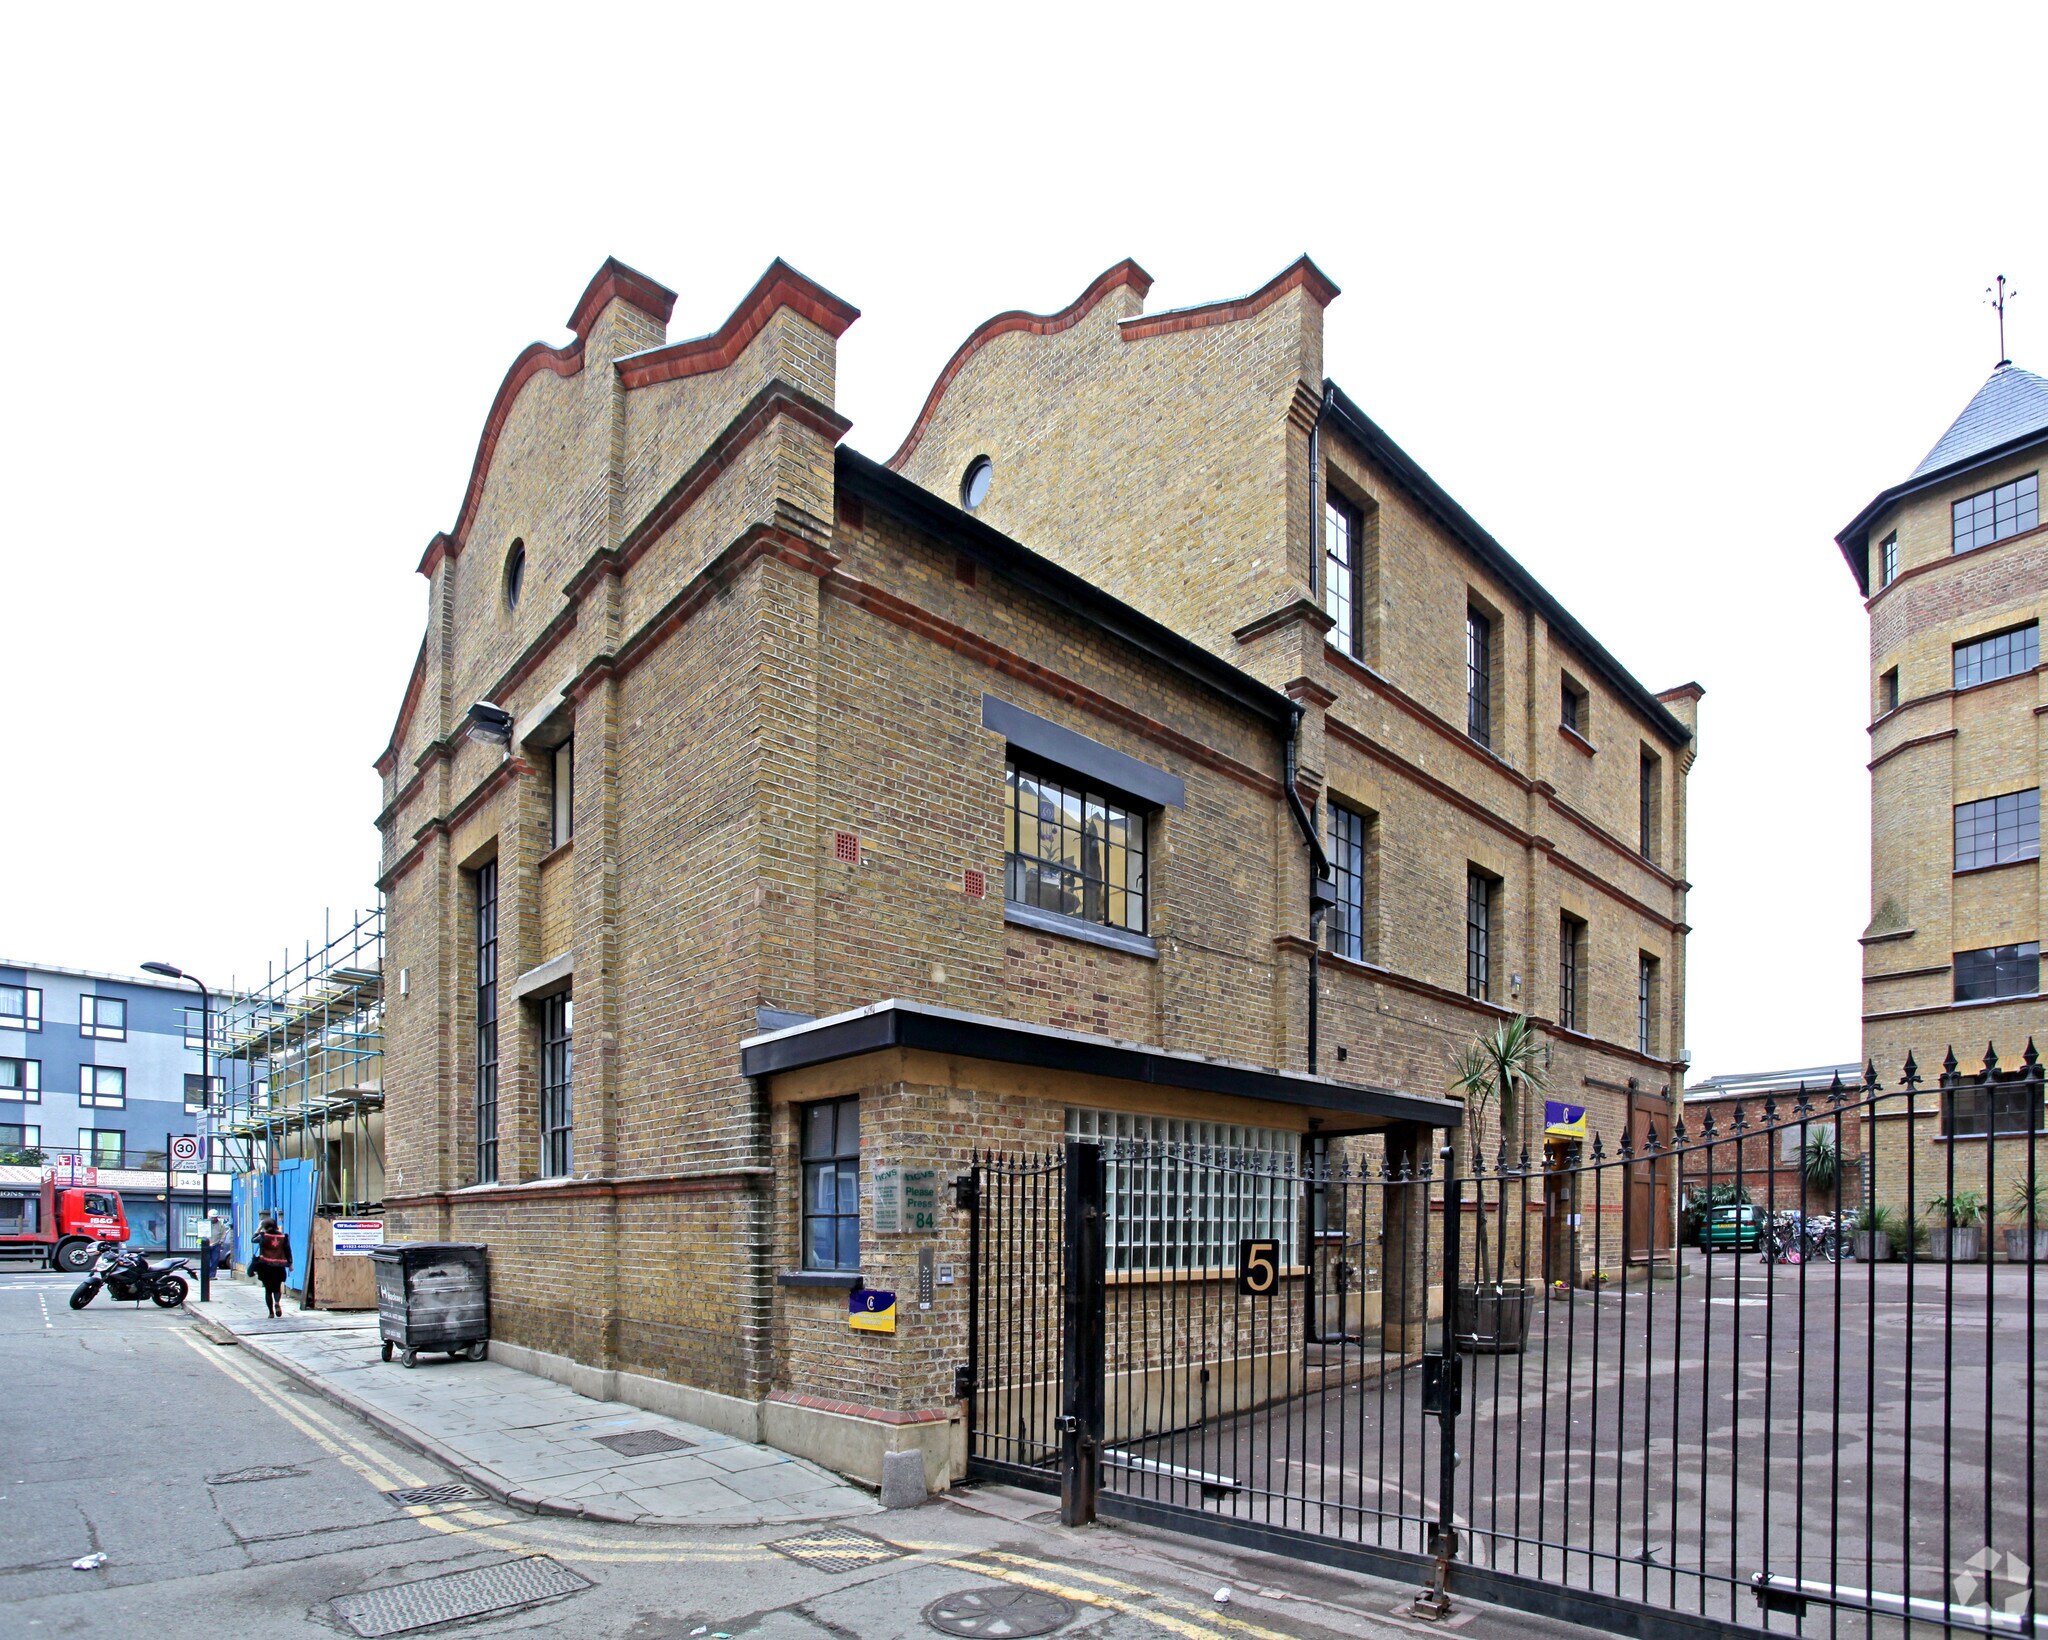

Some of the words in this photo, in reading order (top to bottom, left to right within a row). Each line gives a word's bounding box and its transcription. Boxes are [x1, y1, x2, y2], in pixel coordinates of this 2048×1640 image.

[177, 1143, 194, 1153] 30
[904, 1170, 935, 1181] hcvs
[905, 1186, 935, 1197] Please
[907, 1198, 933, 1208] Press
[915, 1212, 934, 1229] 84
[1246, 1243, 1274, 1292] 5
